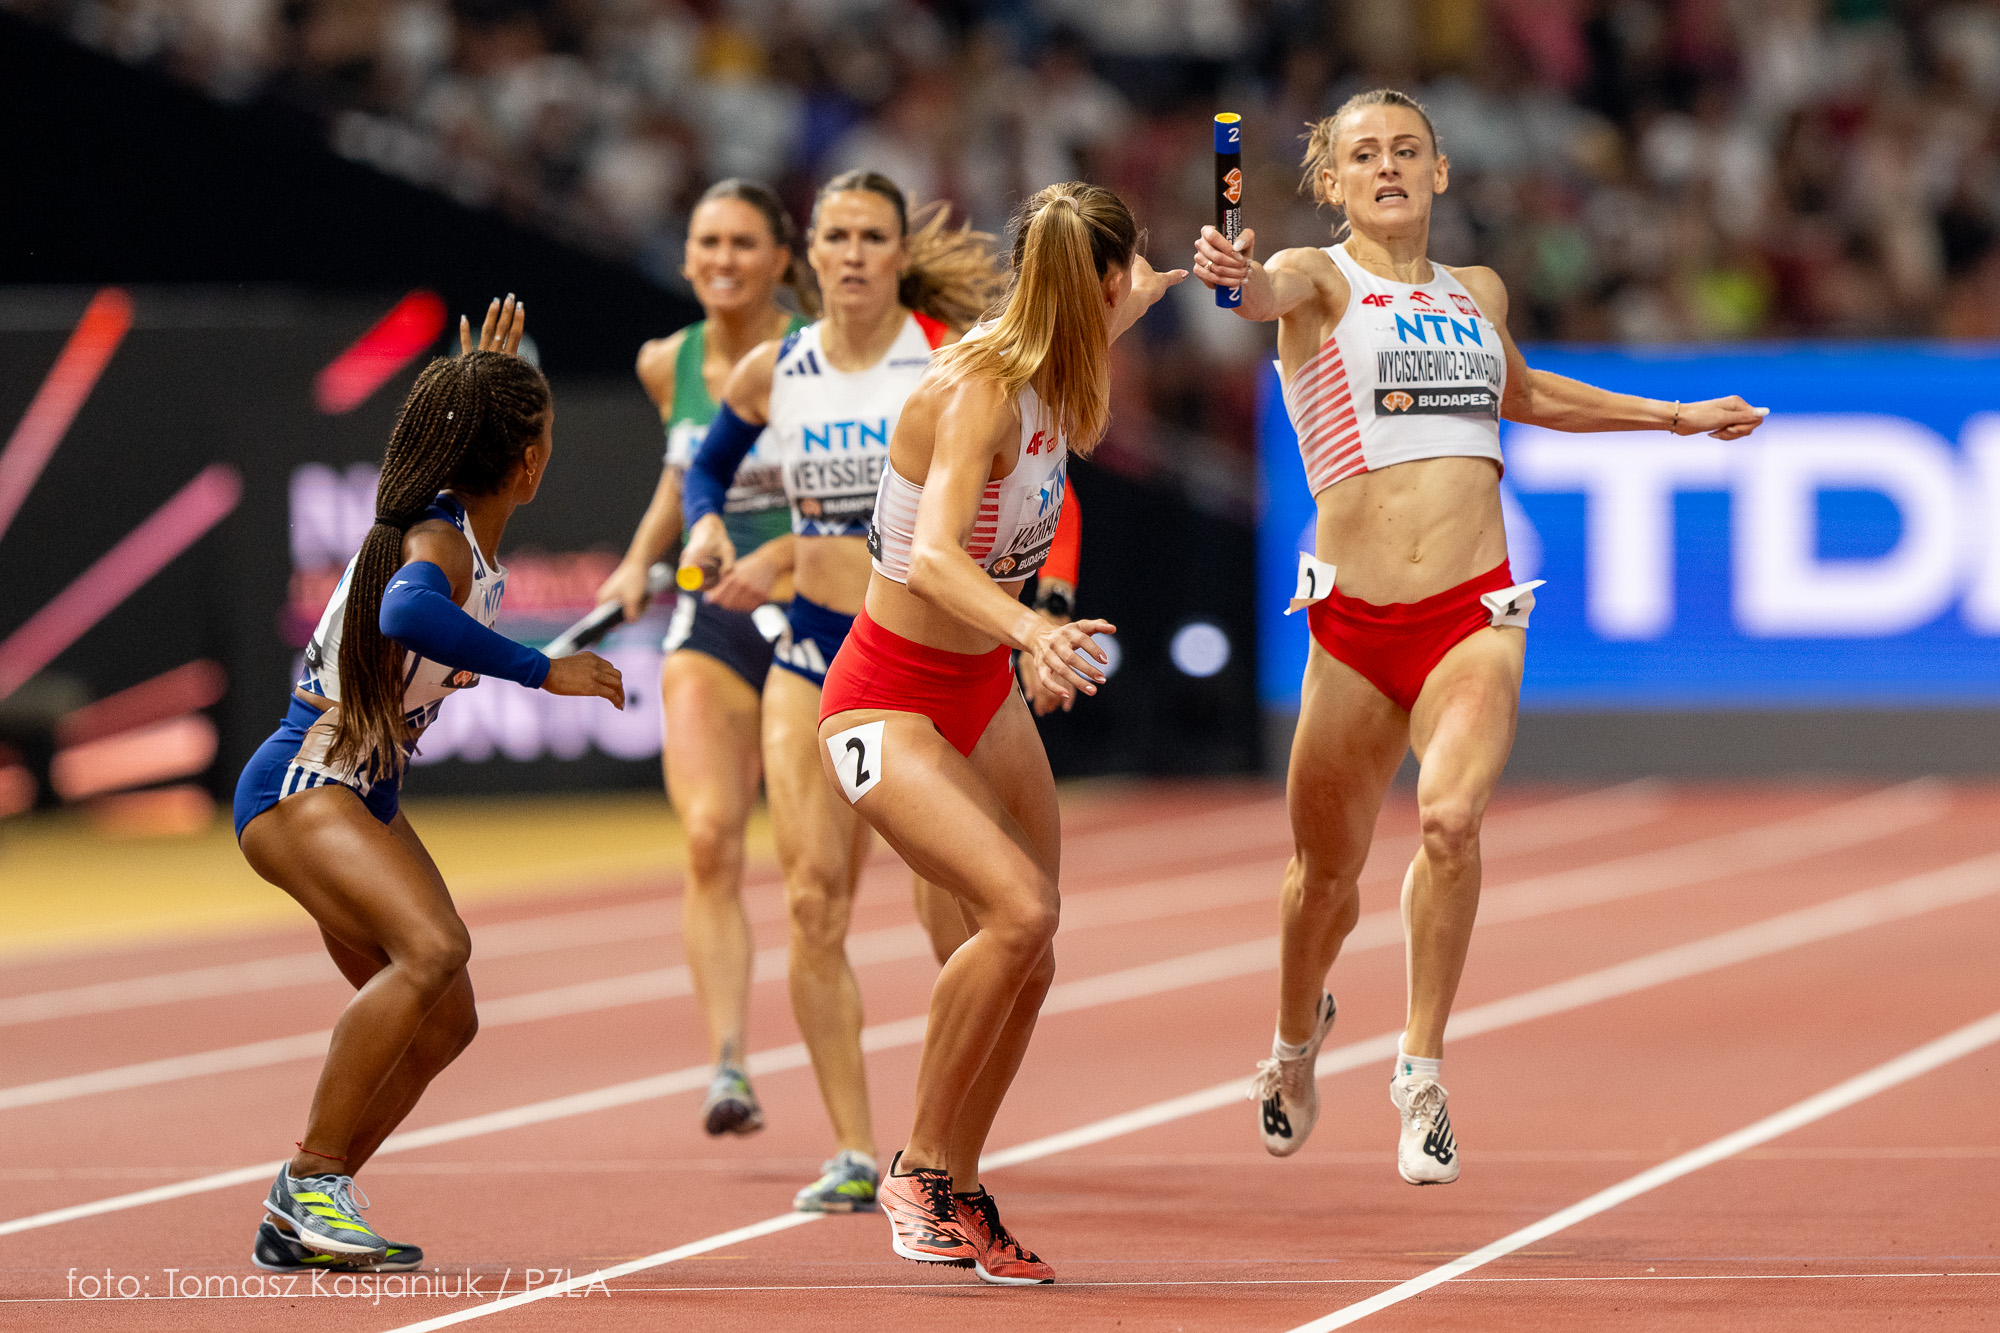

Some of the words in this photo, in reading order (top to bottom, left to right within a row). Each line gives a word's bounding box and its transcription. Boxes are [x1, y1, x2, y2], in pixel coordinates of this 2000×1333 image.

[1228, 127, 1240, 143] 2
[1361, 293, 1394, 307] 4F
[1394, 312, 1483, 348] NTN
[1418, 393, 1493, 407] BUDAPES
[803, 417, 888, 453] NTN
[1026, 430, 1045, 456] 4F
[845, 737, 870, 788] 2
